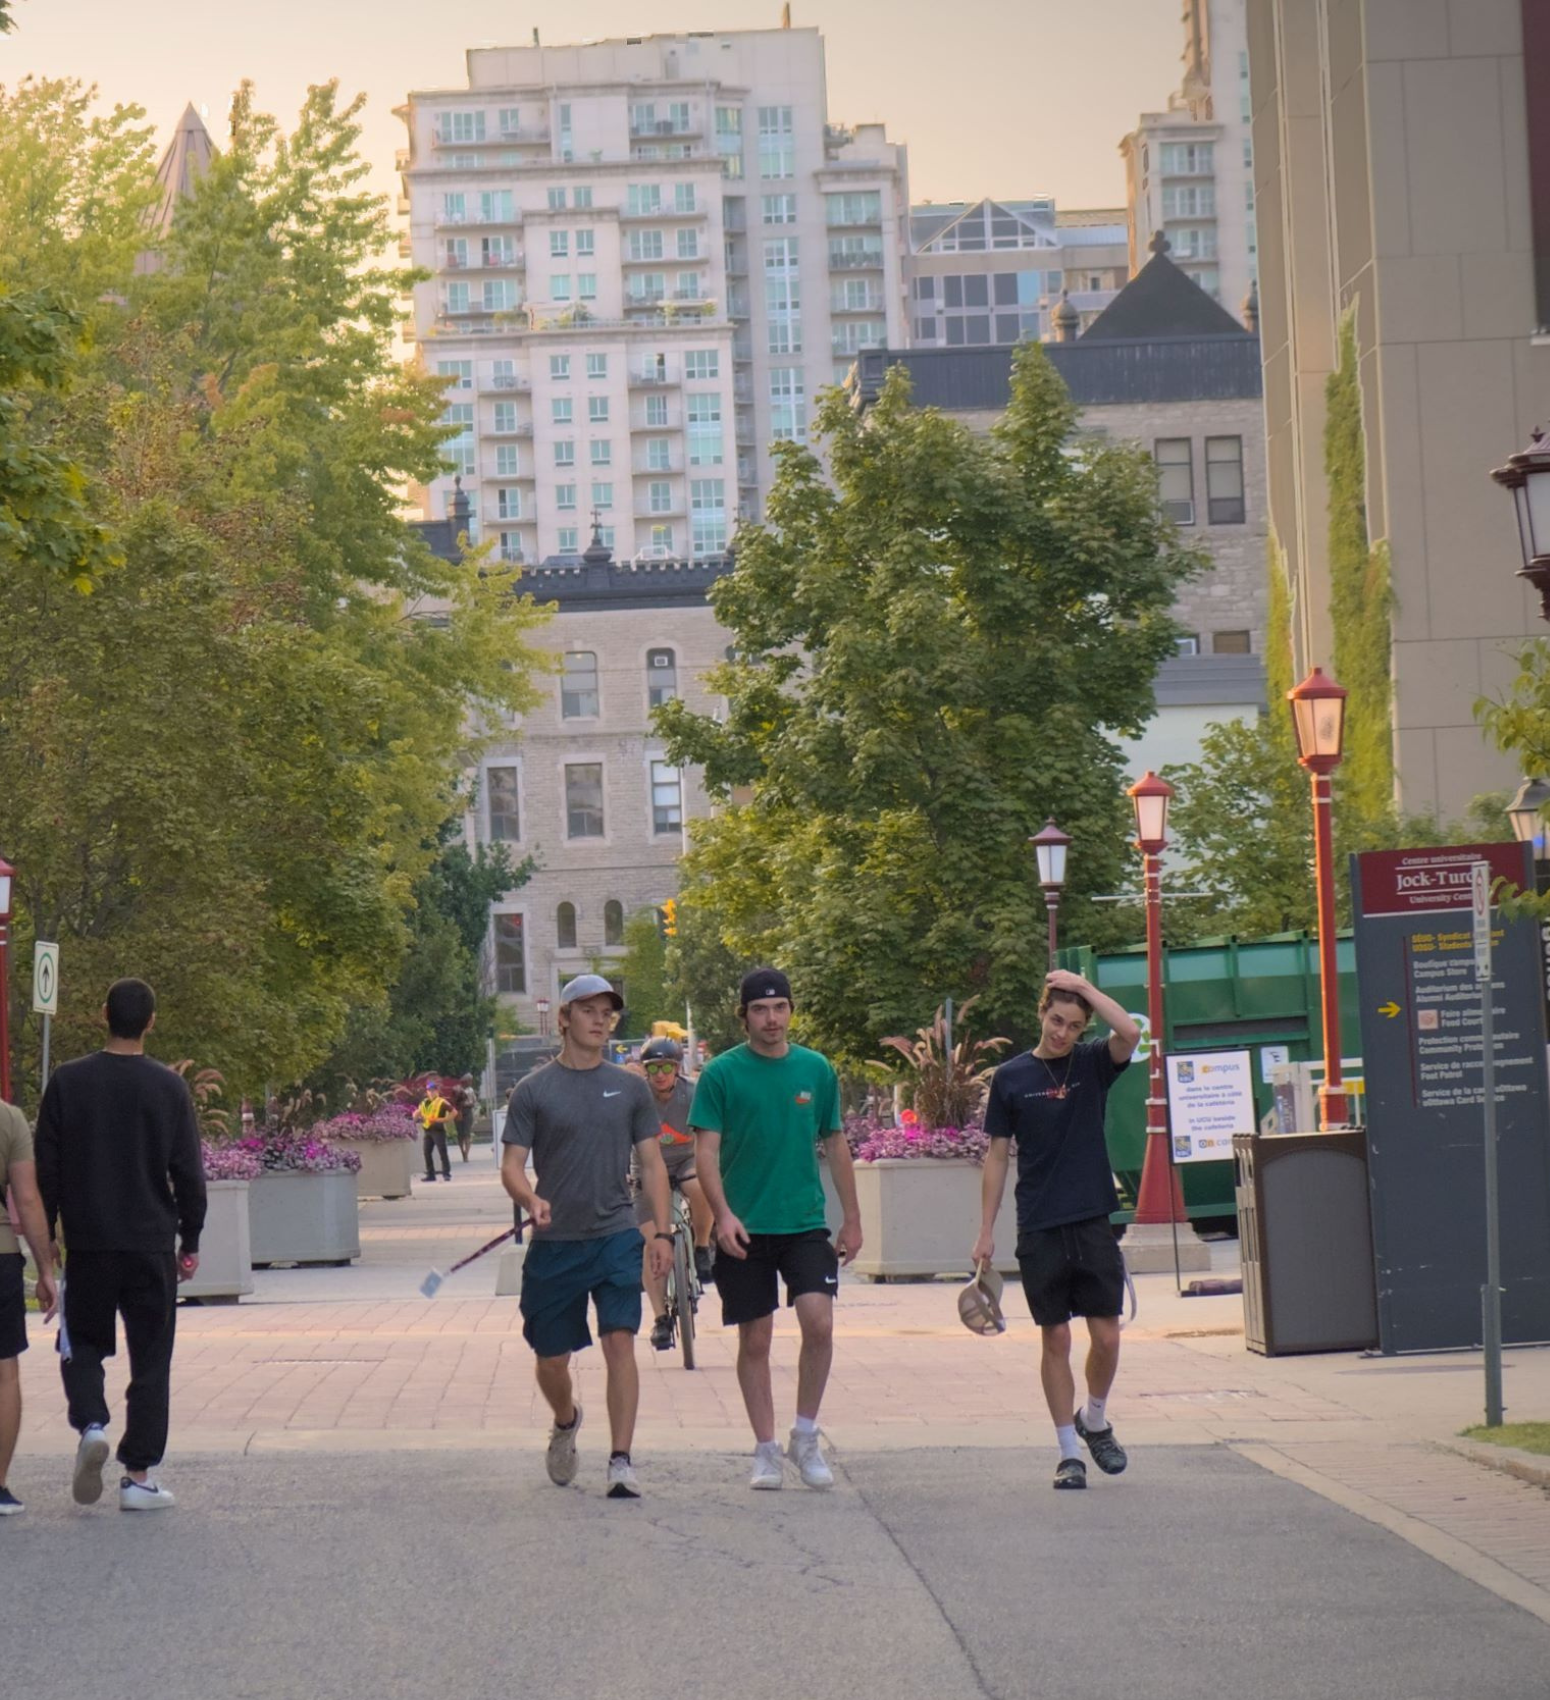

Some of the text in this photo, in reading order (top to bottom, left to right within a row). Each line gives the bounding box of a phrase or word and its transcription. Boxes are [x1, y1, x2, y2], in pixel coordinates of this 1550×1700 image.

[1402, 853, 1482, 866] Centre universitaire
[1396, 871, 1473, 891] Jock-Turc
[1409, 894, 1452, 904] University
[1413, 959, 1447, 970] Boutique
[1414, 968, 1467, 979] Campus Store
[1415, 984, 1458, 994] Auditorium
[1416, 994, 1443, 1003] Alumni
[1441, 1018, 1460, 1028] Food
[1418, 1036, 1458, 1046] Protection
[1419, 1044, 1462, 1055] Community
[1420, 1062, 1449, 1072] Service
[1451, 1061, 1461, 1070] de
[1421, 1070, 1463, 1081] Foot Patrol
[1422, 1088, 1451, 1098] Service
[1452, 1087, 1462, 1096] de
[1456, 1096, 1475, 1105] Card
